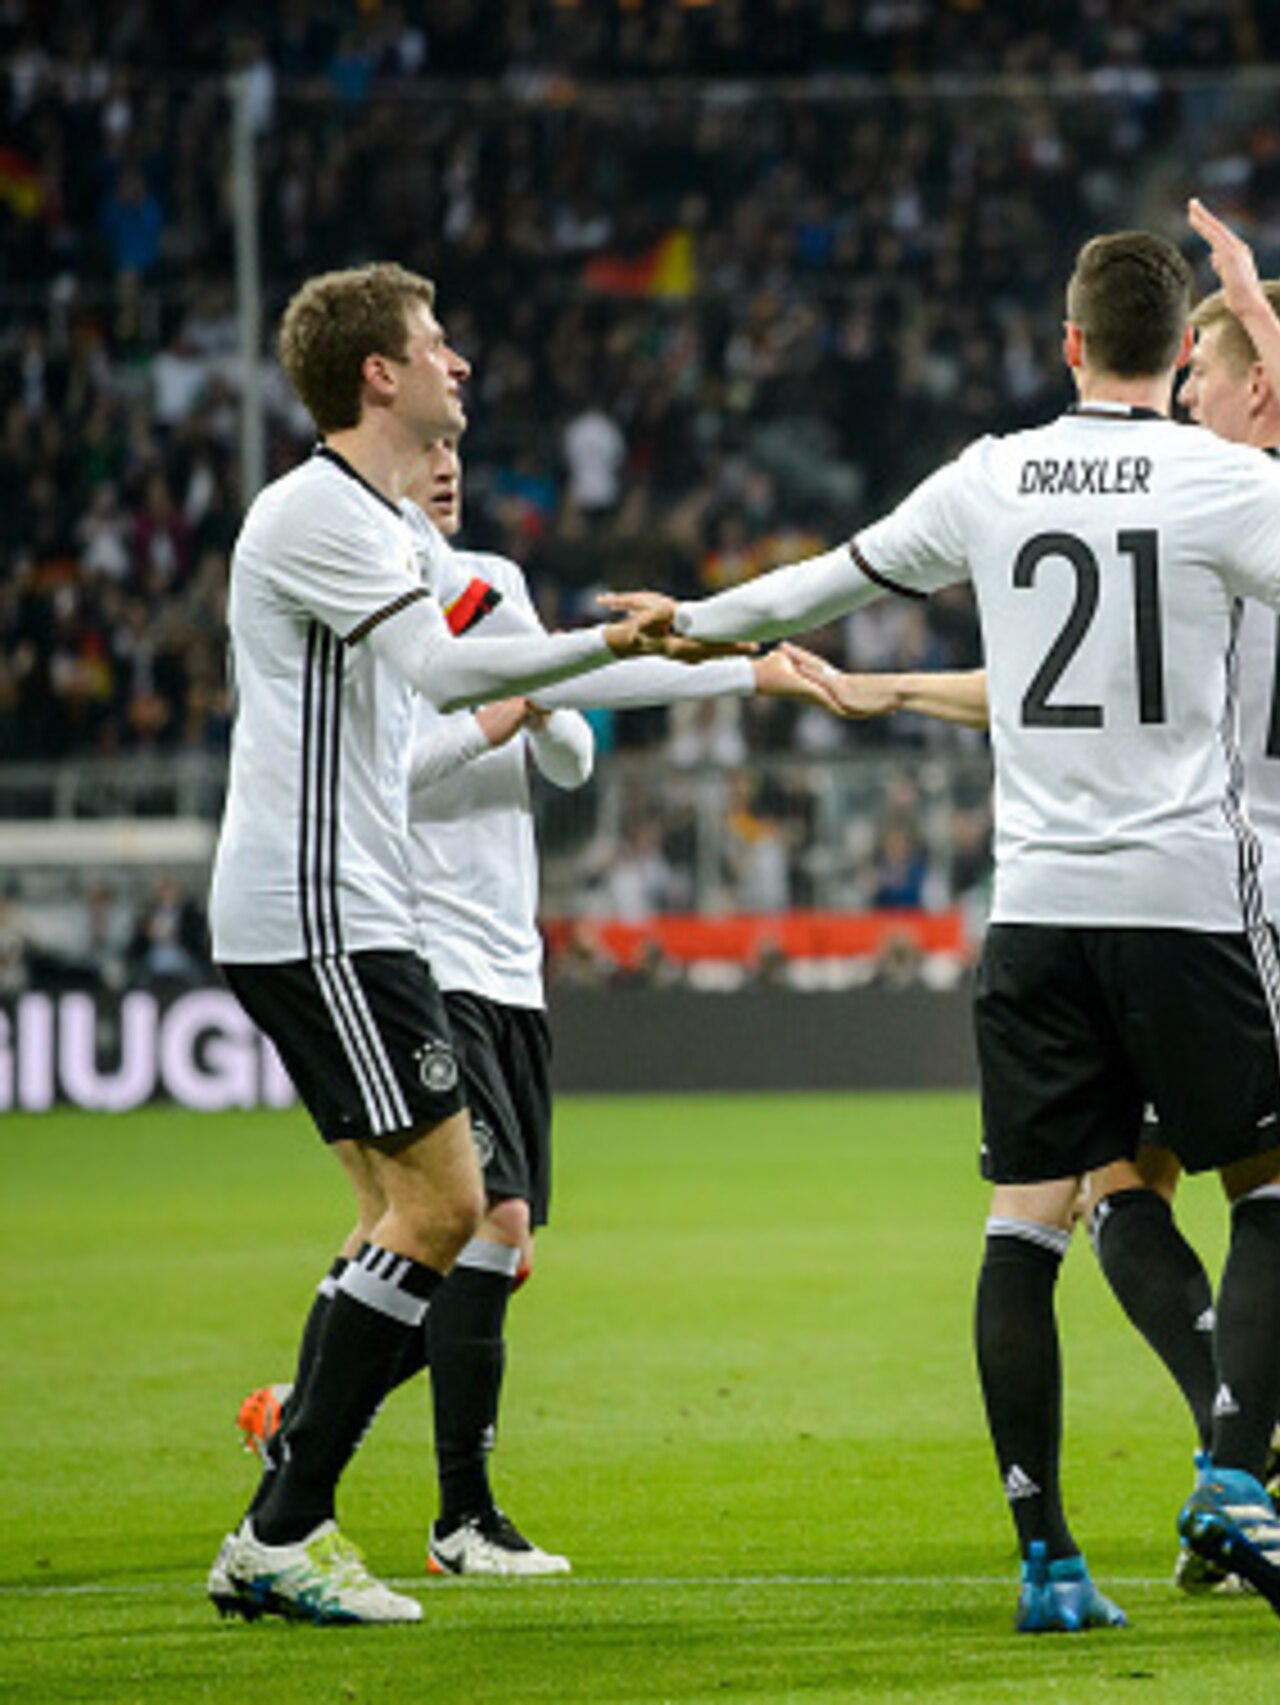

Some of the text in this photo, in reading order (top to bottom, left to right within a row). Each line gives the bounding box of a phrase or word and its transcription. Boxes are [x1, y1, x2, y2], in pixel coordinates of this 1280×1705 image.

[1018, 457, 1154, 495] DRAXLER
[1013, 529, 1166, 728] 21
[0, 988, 298, 1112] IUG
